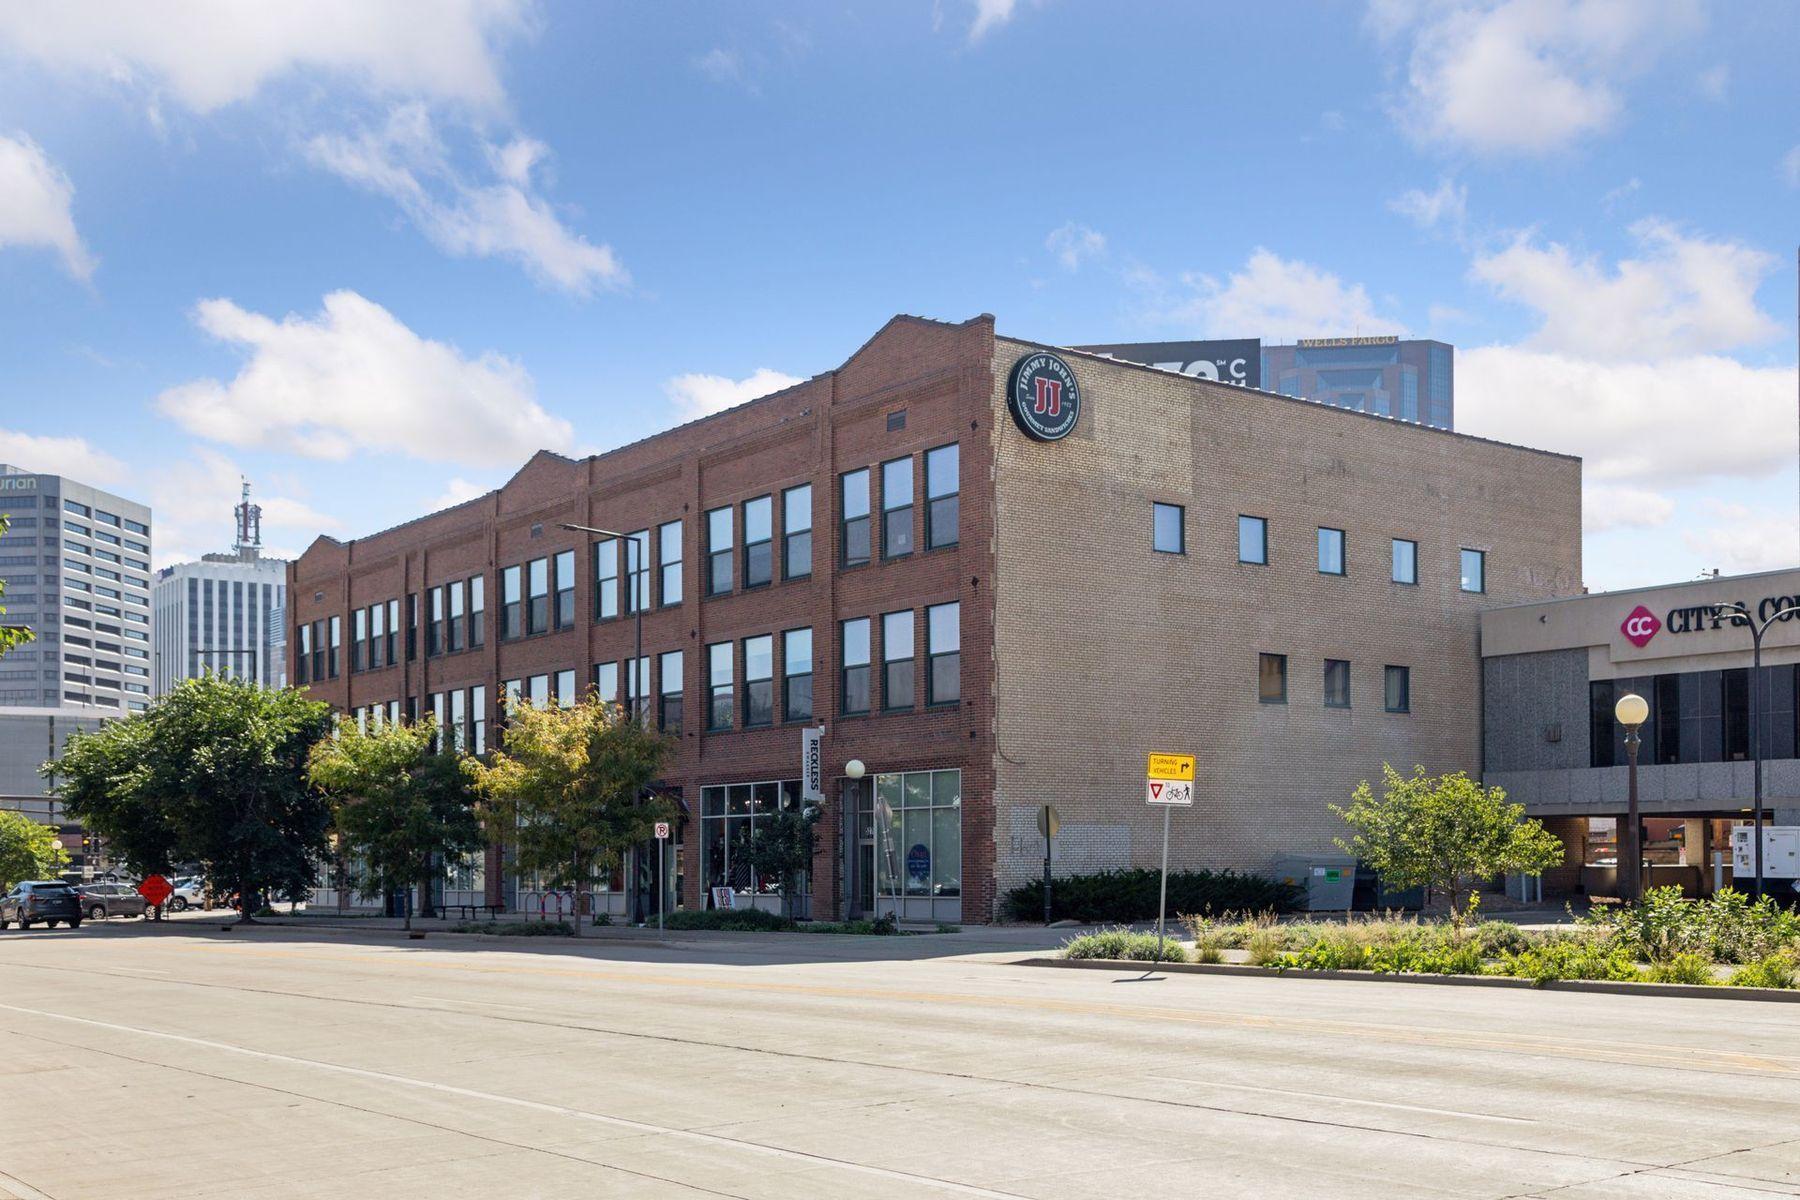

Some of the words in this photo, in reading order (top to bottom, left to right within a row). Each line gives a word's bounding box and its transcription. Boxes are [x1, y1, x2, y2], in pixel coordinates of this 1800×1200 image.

[1302, 337, 1346, 347] WELLS
[1351, 336, 1395, 345] FARGO
[1020, 358, 1046, 390] JIMMY
[1049, 359, 1076, 400] JOHN'S
[1666, 604, 1724, 634] CITY
[810, 739, 819, 791] RECKLESS
